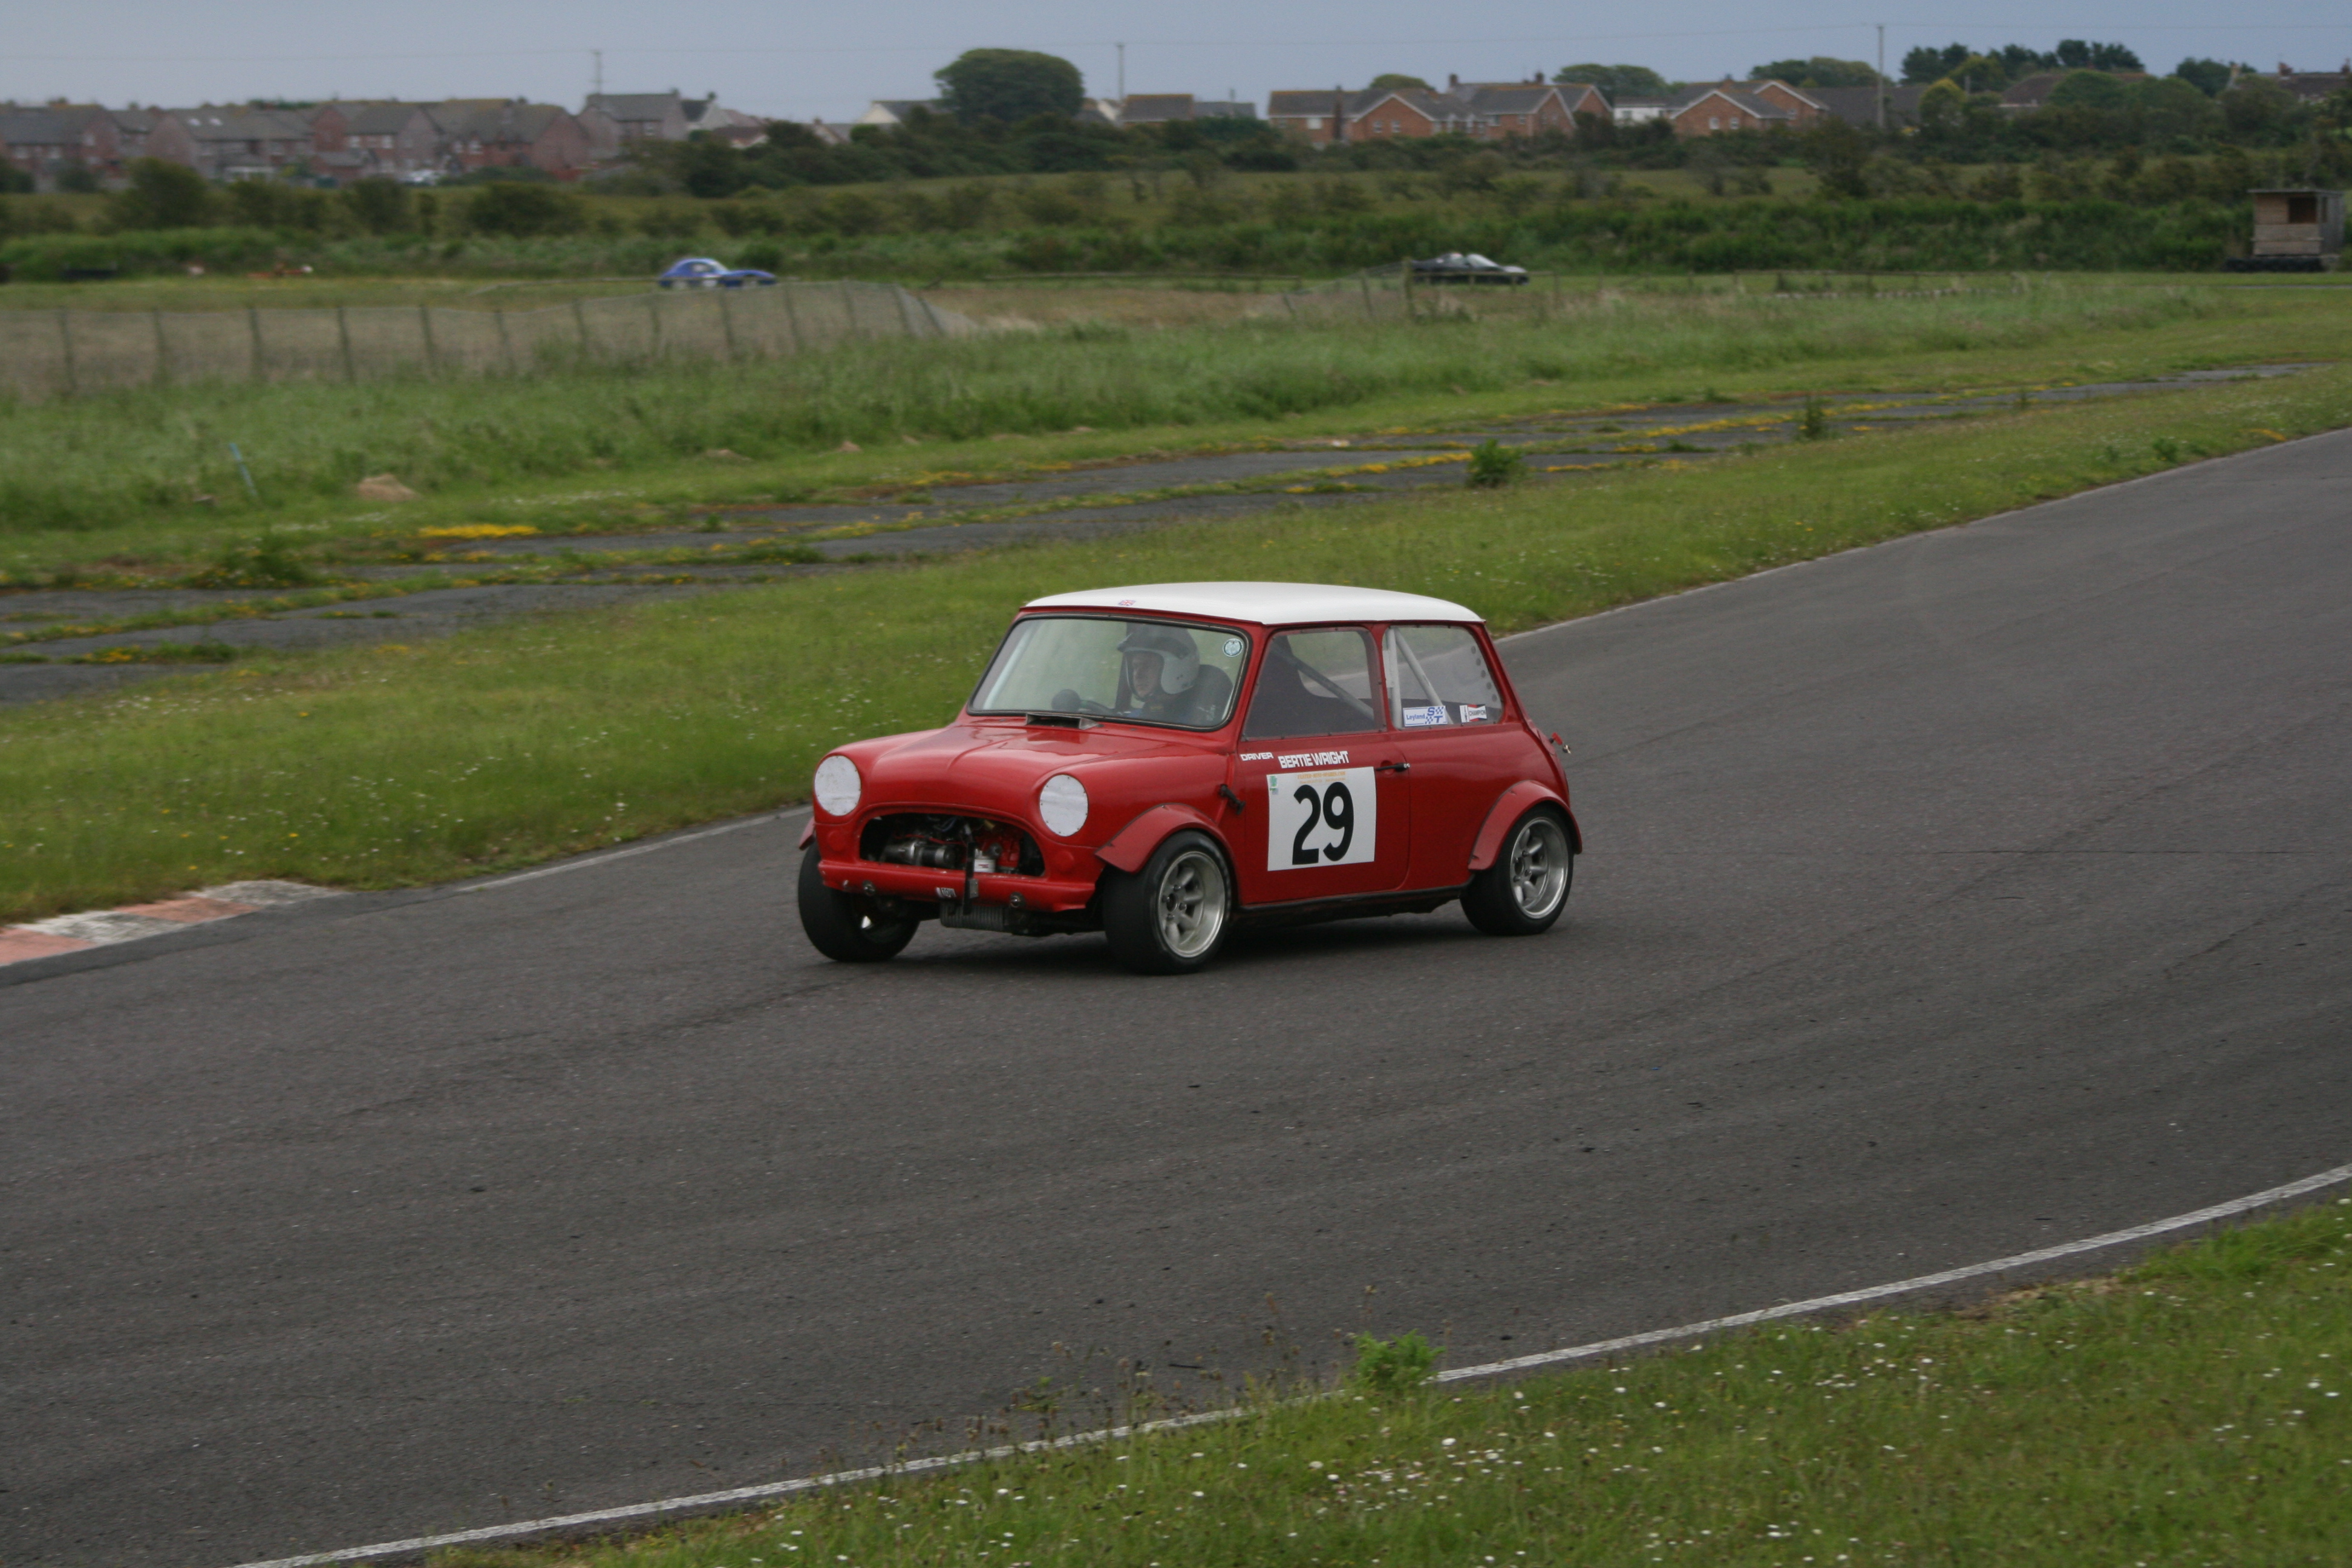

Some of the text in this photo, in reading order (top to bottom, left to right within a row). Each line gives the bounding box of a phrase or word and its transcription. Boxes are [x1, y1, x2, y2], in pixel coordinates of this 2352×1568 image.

[1240, 751, 1350, 768] DRIVER BERTIE WRIGHT
[1292, 782, 1354, 865] 29
